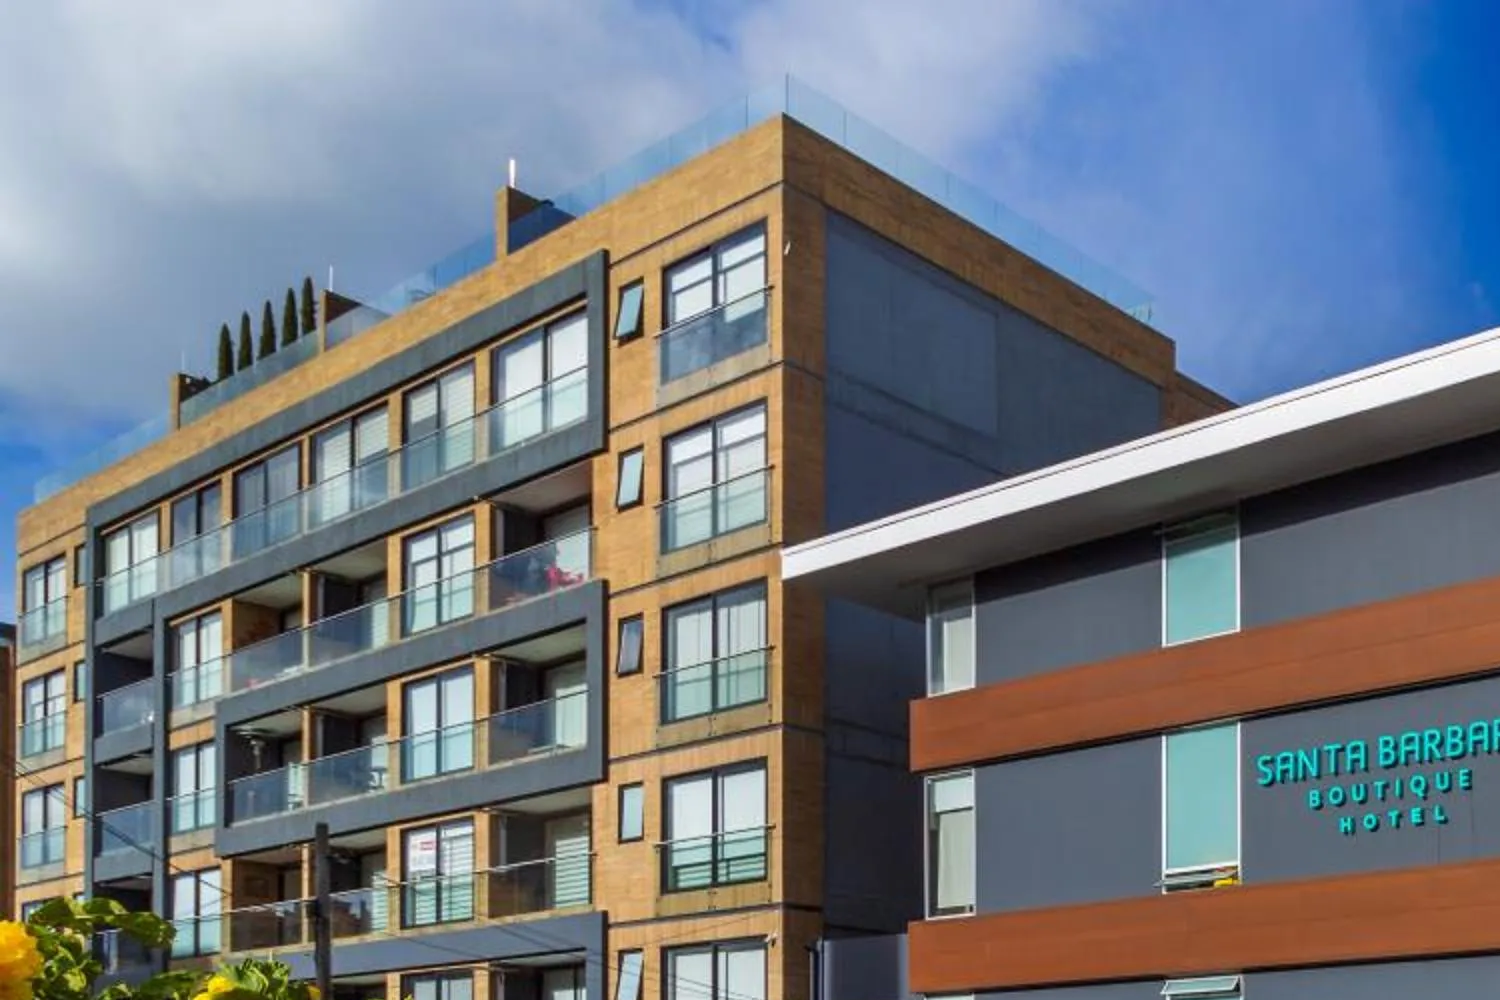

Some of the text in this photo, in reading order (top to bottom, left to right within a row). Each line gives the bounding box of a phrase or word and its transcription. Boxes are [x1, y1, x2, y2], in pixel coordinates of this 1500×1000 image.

[1257, 739, 1367, 786] SANTA
[1309, 768, 1473, 809] BOUTIQUE
[1339, 804, 1448, 833] HOTEL
